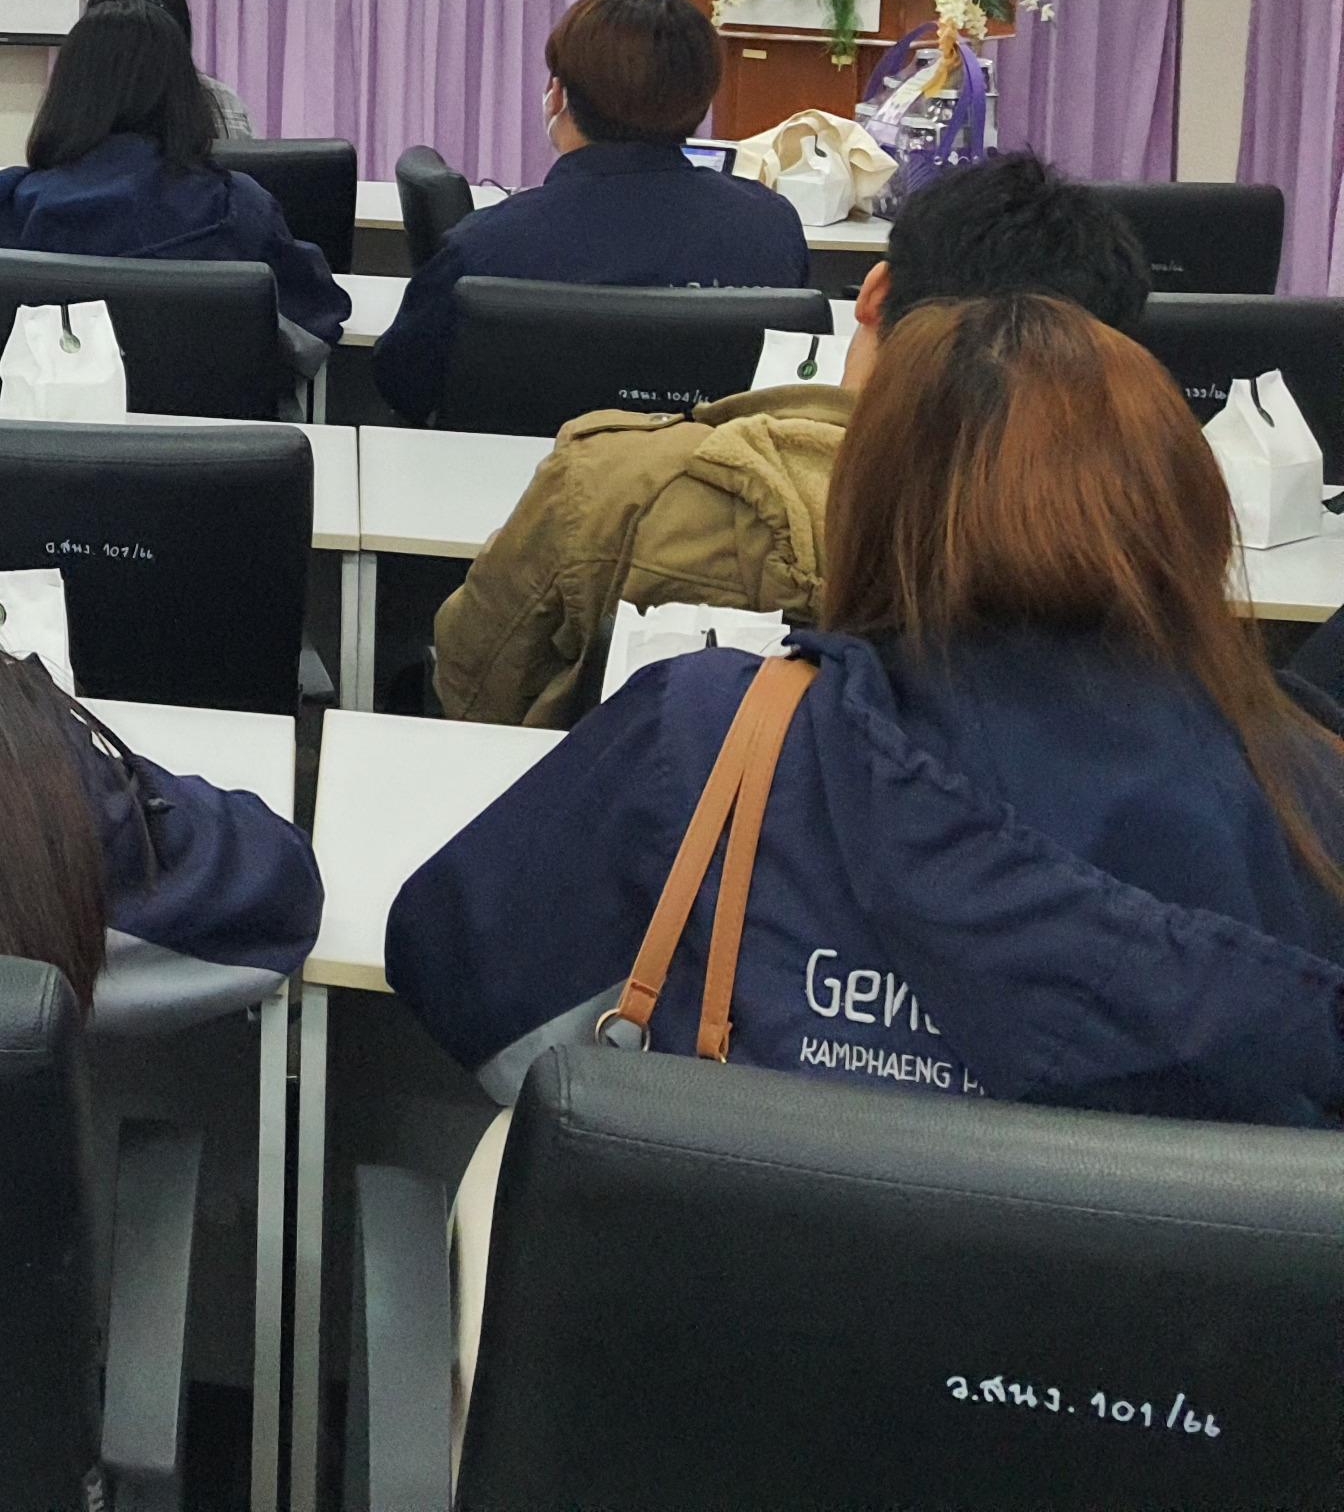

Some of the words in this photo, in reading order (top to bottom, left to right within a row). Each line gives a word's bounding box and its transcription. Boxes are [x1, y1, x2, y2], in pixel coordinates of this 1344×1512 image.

[805, 948, 942, 1036] Gen
[800, 1036, 953, 1089] KAMPHAENG
[1090, 1391, 1222, 1438] 101/66
